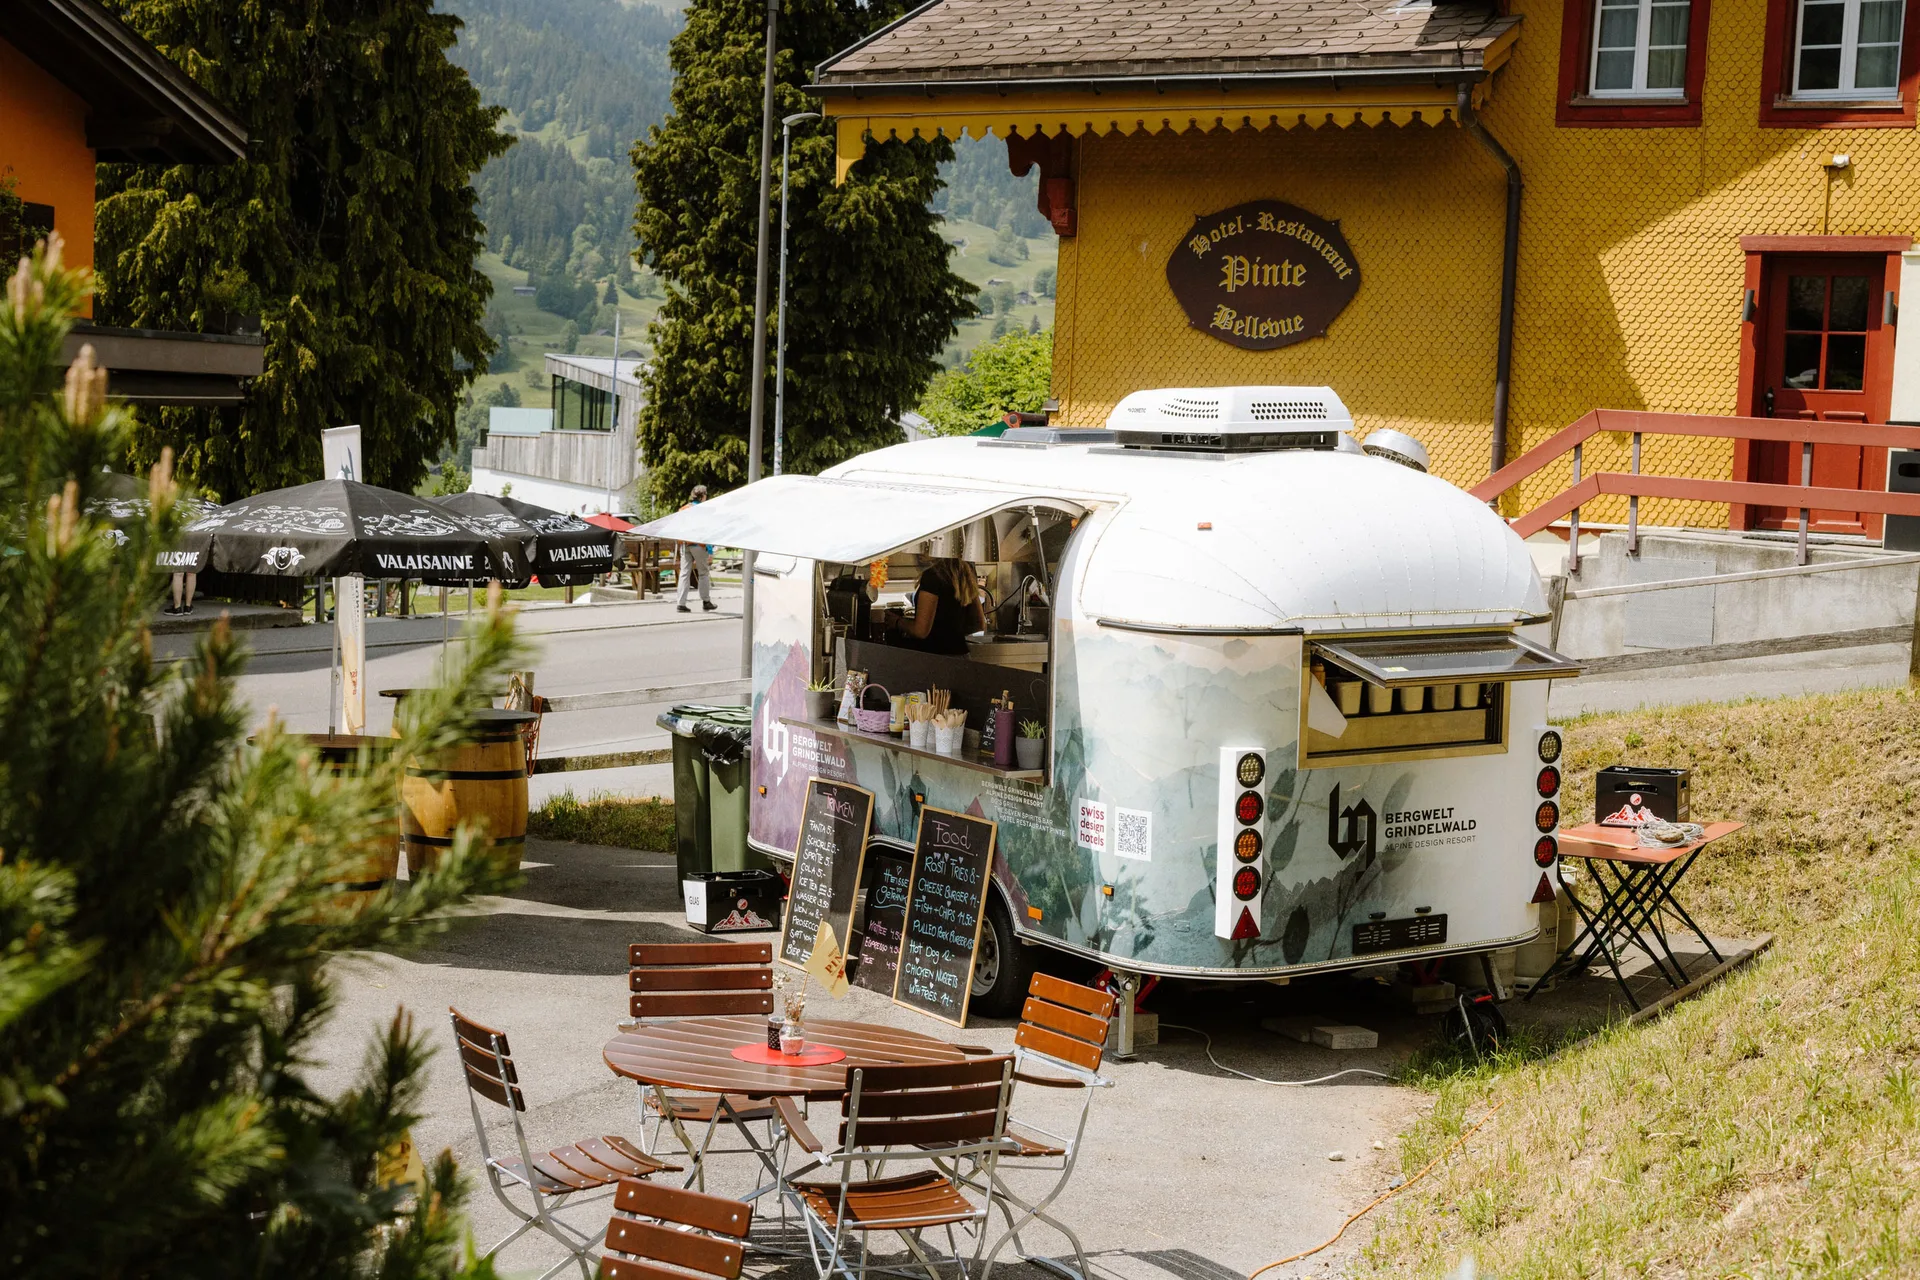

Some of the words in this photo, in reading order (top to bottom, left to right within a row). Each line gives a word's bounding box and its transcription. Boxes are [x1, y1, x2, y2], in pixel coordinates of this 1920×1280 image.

[1218, 255, 1307, 293] Pinte
[1209, 303, 1304, 340] Bellevue
[549, 544, 612, 562] VALAISANNE
[376, 554, 474, 570] VALAISANNE
[792, 734, 833, 753] BERGWELT
[792, 746, 846, 768] GRINDELWALD
[792, 761, 808, 770] ALPINE
[809, 764, 827, 774] DESIGN
[827, 769, 846, 778] RESORT
[981, 780, 1007, 792] BERGWELT
[1008, 786, 1044, 800] GRINDELWALD
[986, 789, 1004, 798] ALPINE
[1004, 792, 1023, 803] DESIGN
[1023, 798, 1044, 808] RESORT
[1081, 806, 1105, 820] swiss
[1385, 807, 1455, 824] BERGWELT
[809, 819, 825, 833] FANTA
[999, 815, 1015, 824] HOTEL
[1016, 818, 1050, 832] RESTAURANT
[1080, 818, 1105, 834] design
[1385, 819, 1477, 839] GRINDELWALD
[806, 834, 831, 852] SCHORLE
[932, 820, 971, 850] Food
[1080, 830, 1104, 846] hotels
[1384, 841, 1413, 850] ALPINE
[1415, 839, 1444, 849] DESIGN
[1446, 835, 1476, 845] RESORT
[803, 848, 824, 864] SPRITE
[801, 862, 816, 875] COLA
[950, 857, 968, 882] FRIES
[796, 890, 817, 904] WASSER
[918, 878, 944, 896] CHEESE
[944, 885, 968, 903] BURGER
[689, 896, 700, 906] GLAS
[914, 898, 932, 914] FISH
[938, 905, 956, 922] CHIPS
[913, 920, 936, 937] PULLED
[864, 936, 888, 951] ESPRESSO
[905, 963, 934, 979] CHICKEN
[935, 969, 958, 988] NUGGETS
[921, 985, 937, 1002] FRIES
